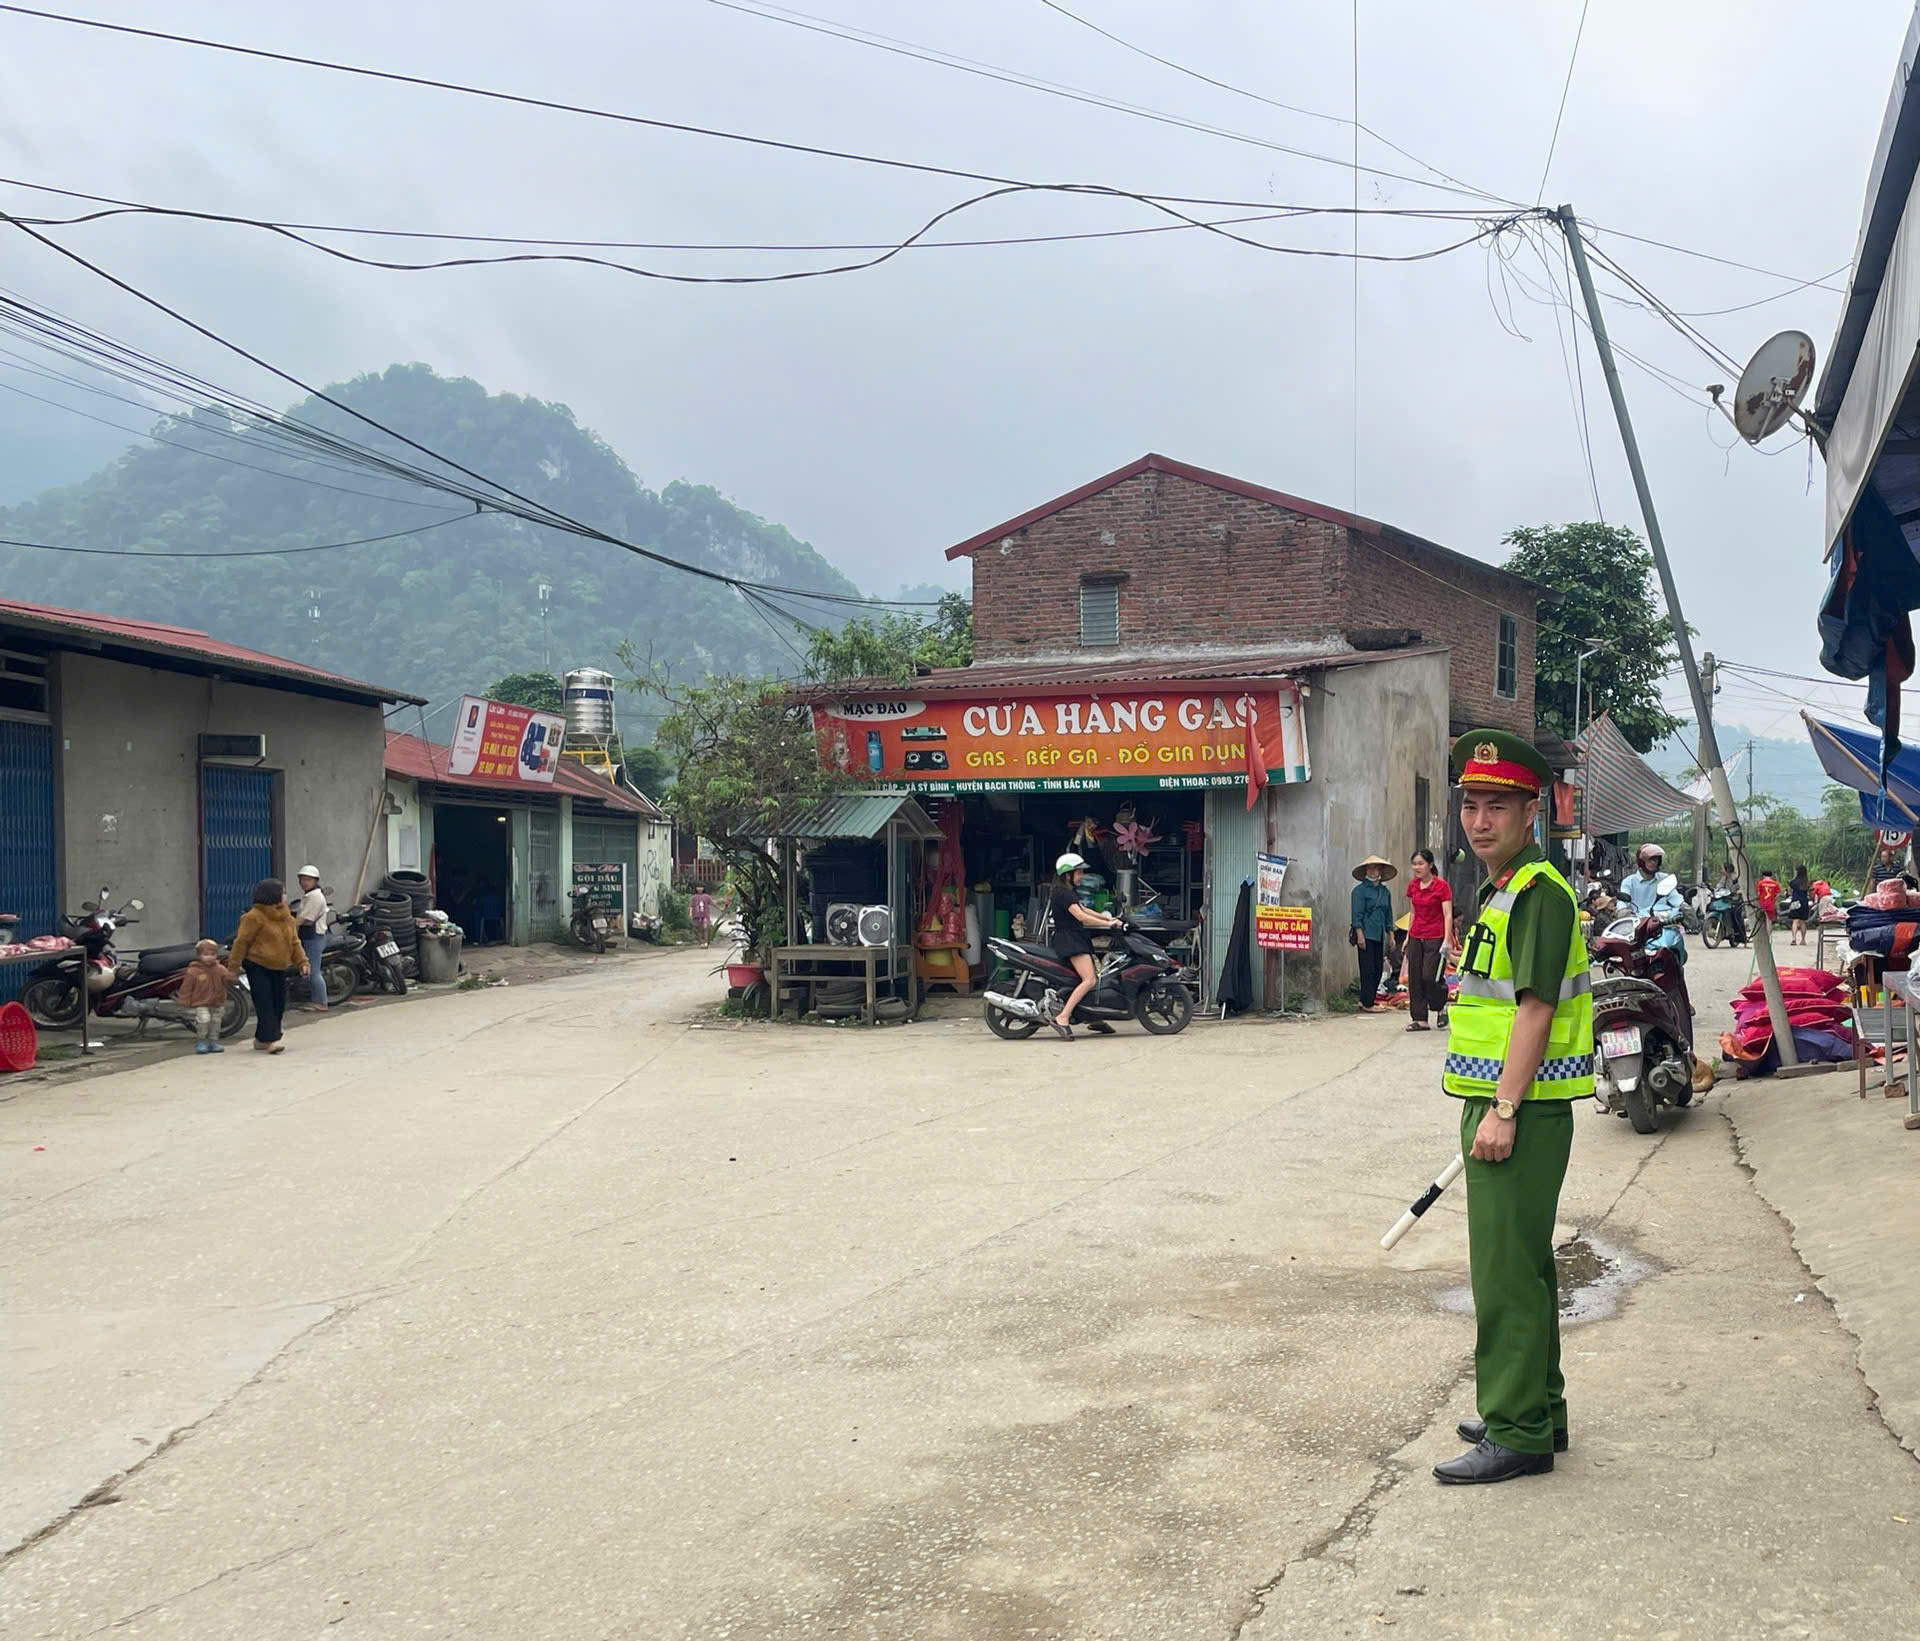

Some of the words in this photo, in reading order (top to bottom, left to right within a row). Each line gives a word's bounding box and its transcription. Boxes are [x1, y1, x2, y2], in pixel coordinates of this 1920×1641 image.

[843, 703, 873, 718] MẠC
[1054, 694, 1167, 734] HÀNG
[1178, 696, 1258, 730] GAS
[966, 750, 1006, 767] GAS
[1026, 743, 1061, 766] BẾP
[1068, 749, 1098, 765] GA
[1118, 741, 1150, 764] ĐỒ
[1157, 745, 1194, 763] GIA
[929, 781, 949, 792] BÌNH
[956, 780, 983, 792] HUYỆN
[984, 781, 1007, 792] BẠCH
[1008, 779, 1036, 790] THÔNG
[1043, 778, 1062, 789] TỈNH
[1082, 779, 1101, 791] KẠN
[1159, 777, 1180, 788] ĐIỆN
[1182, 777, 1209, 788] THOẠI:
[1211, 776, 1232, 787] 0989
[1259, 920, 1273, 930] KHU
[1274, 921, 1289, 932] VỰC
[1290, 920, 1309, 932] CẤM
